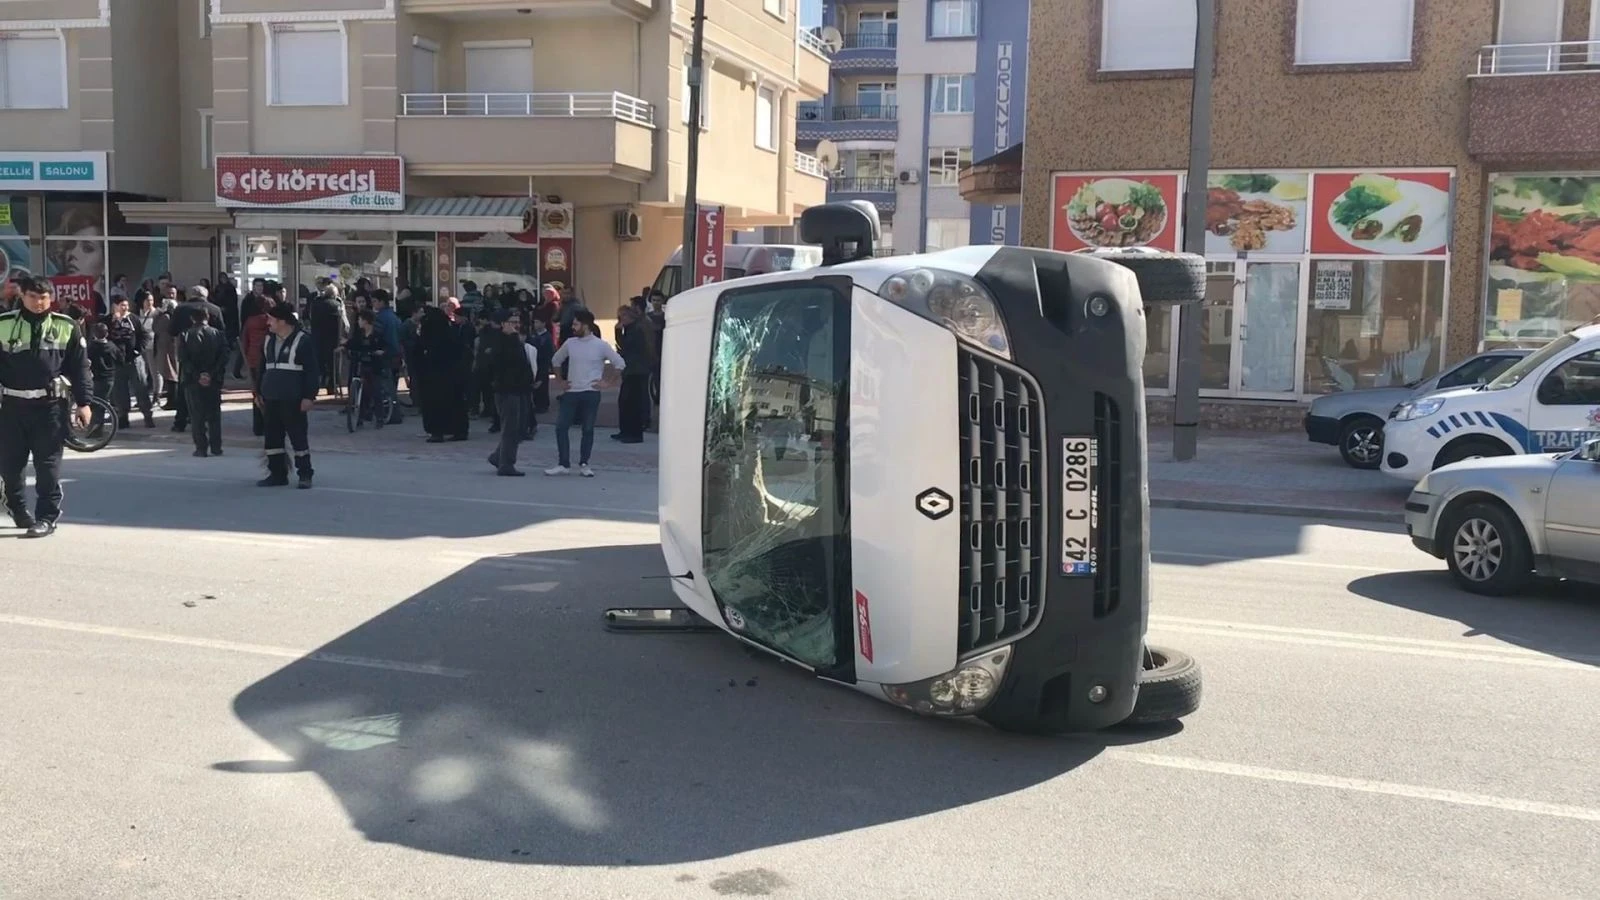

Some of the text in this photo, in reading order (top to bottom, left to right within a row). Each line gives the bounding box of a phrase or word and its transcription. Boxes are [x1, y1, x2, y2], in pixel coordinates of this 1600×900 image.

[995, 42, 1012, 154] TORUNMU
[45, 166, 88, 176] SALONU
[240, 168, 274, 193] ÇİĞ
[277, 168, 376, 192] KÖFTECİSİ
[1065, 441, 1088, 561] 42 C 0286
